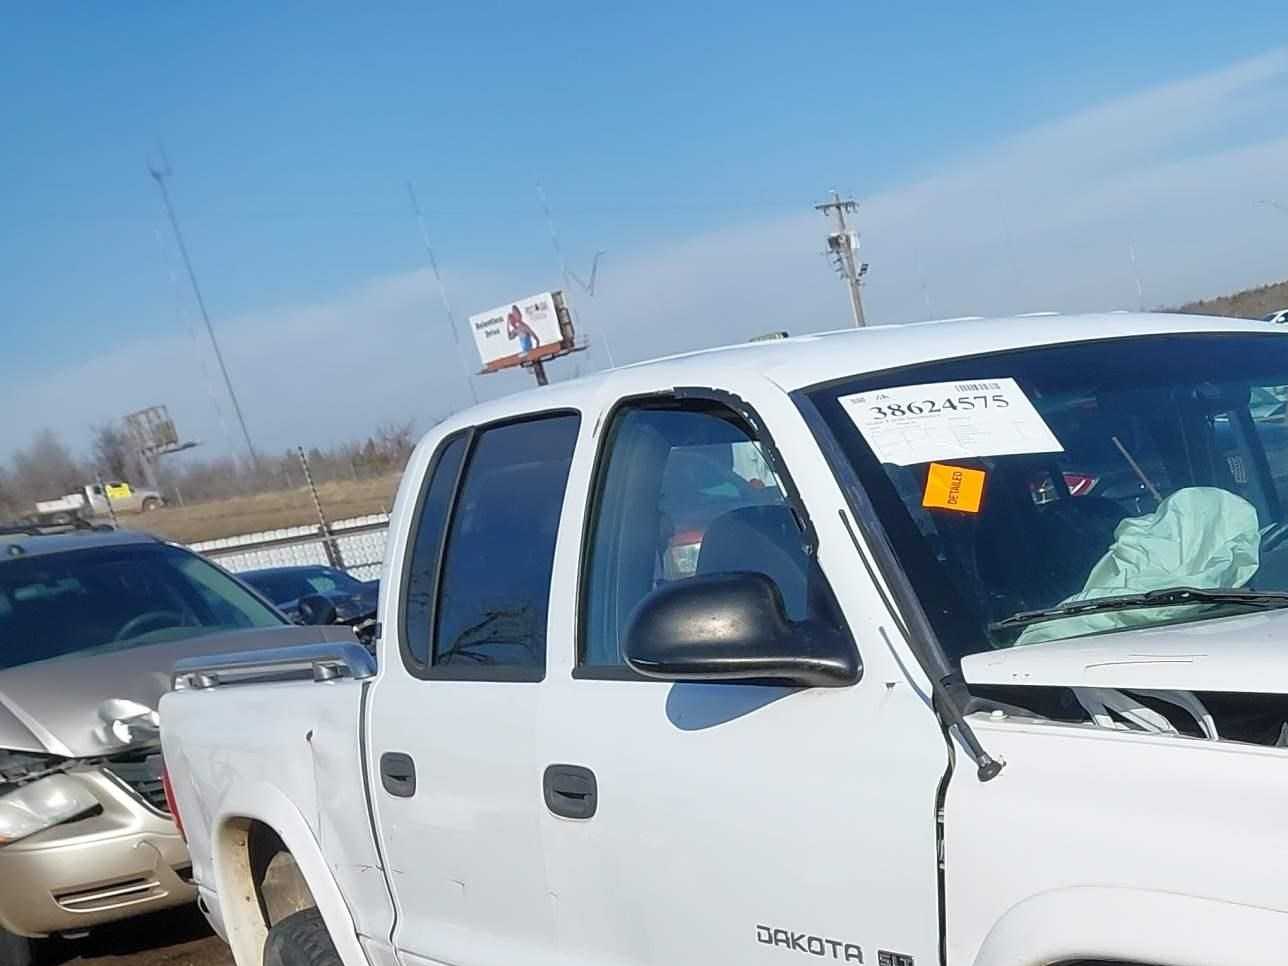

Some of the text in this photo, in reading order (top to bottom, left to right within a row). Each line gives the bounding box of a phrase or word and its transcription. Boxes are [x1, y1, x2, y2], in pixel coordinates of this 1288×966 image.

[869, 395, 1010, 420] 38624575
[947, 471, 962, 505] DETAILED
[756, 924, 864, 964] DAKOTA
